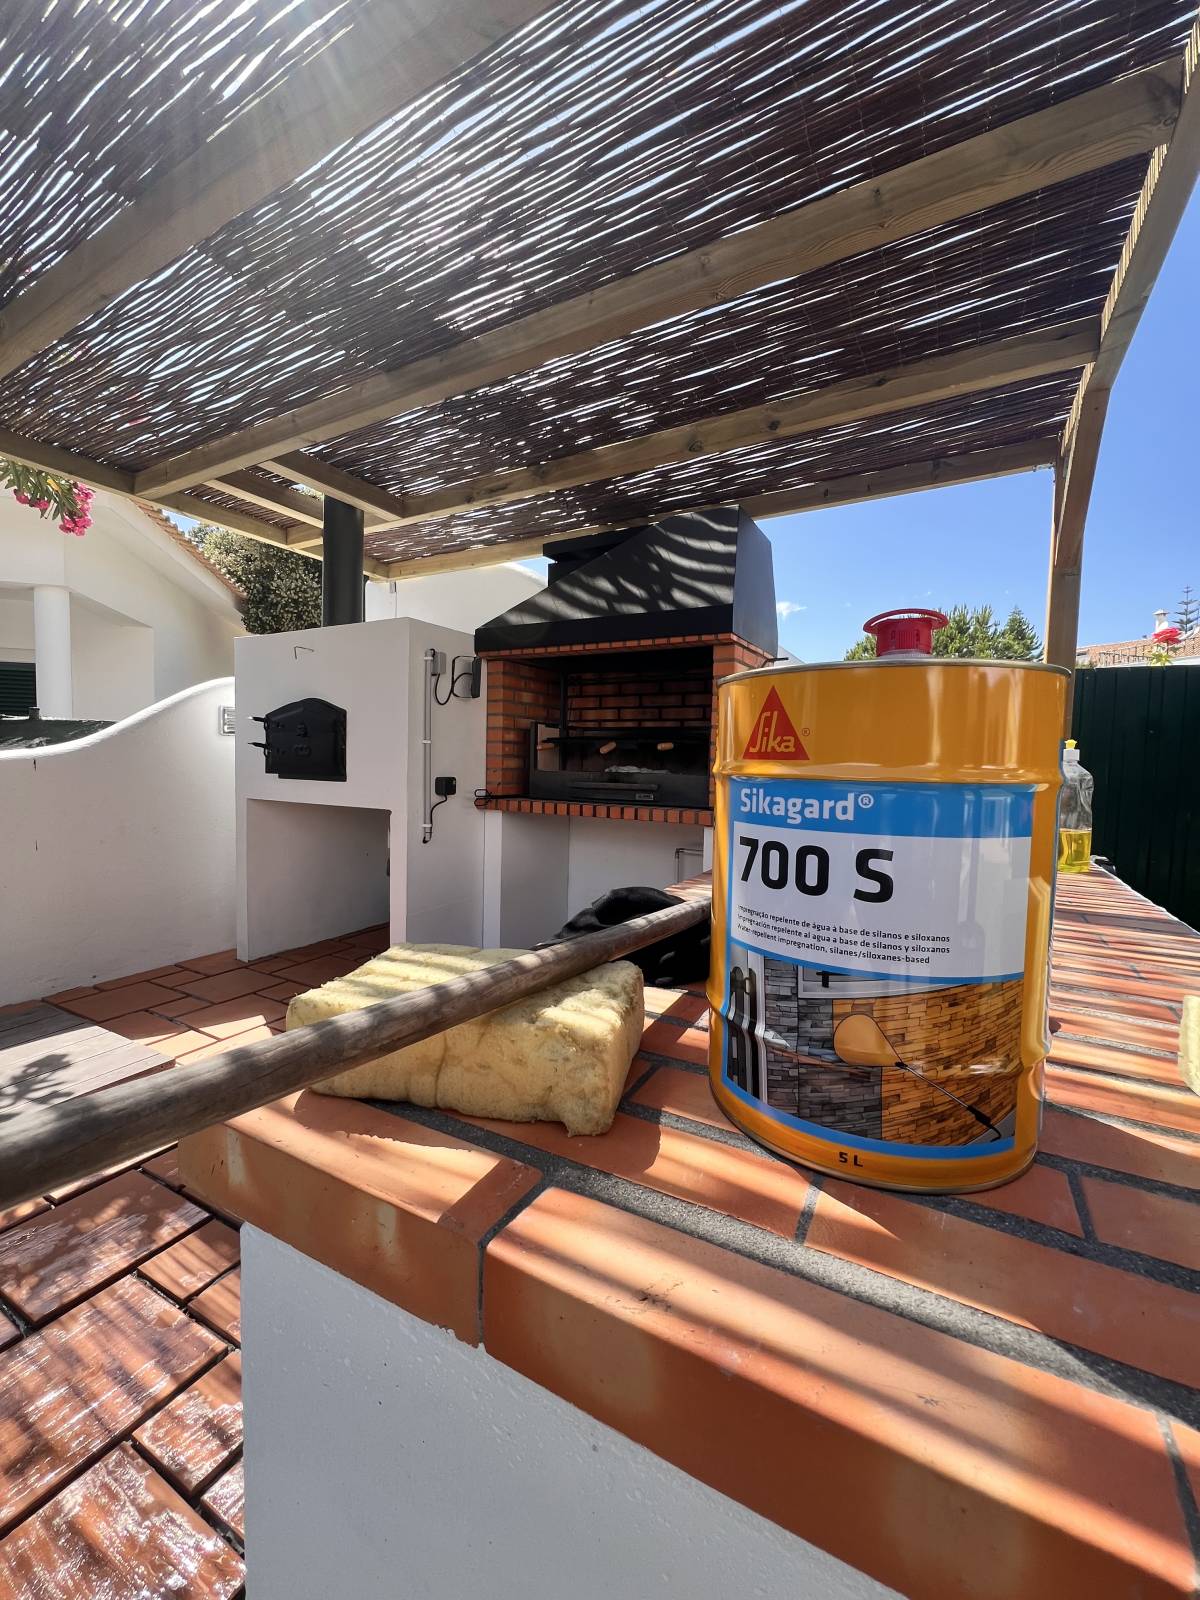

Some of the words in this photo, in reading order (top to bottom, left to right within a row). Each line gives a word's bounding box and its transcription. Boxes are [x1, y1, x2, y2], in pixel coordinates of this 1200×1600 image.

[739, 835, 830, 896] 700
[853, 848, 894, 903] S
[769, 913, 800, 926] repelente
[812, 922, 831, 931] água
[839, 925, 858, 935] base
[860, 928, 871, 936] de
[872, 930, 902, 940] silanos
[911, 933, 950, 942] siloxanos
[771, 925, 802, 937] repelente
[812, 934, 831, 942] agua
[839, 937, 858, 946] base
[860, 939, 871, 947] de
[872, 941, 902, 950] silanos
[904, 945, 910, 953] y
[911, 944, 950, 953] siloxanos
[778, 936, 828, 953] impregnation,
[829, 946, 930, 963] silanes/siloxanes-based
[839, 1151, 848, 1163] 5
[853, 1154, 863, 1167] L
